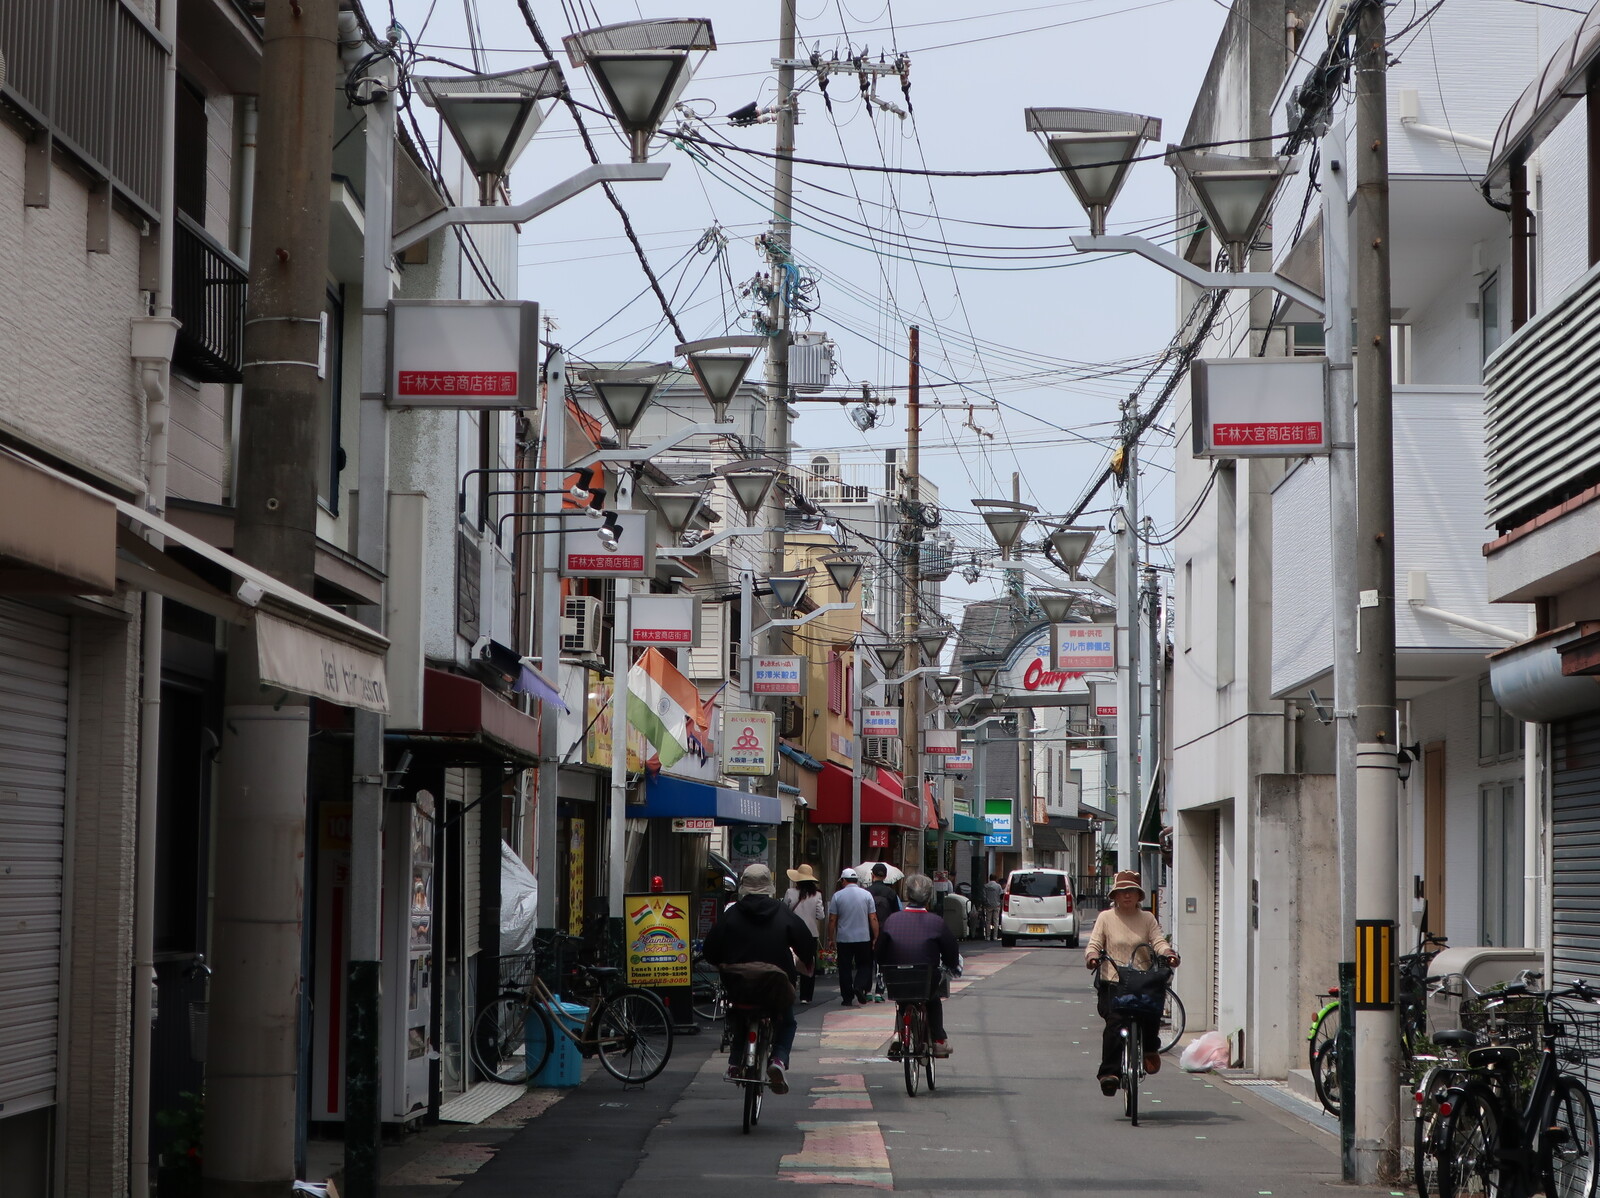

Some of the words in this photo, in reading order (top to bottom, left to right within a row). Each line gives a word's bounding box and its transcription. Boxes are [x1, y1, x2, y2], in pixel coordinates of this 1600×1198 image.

[401, 375, 514, 393] 千林大宮商店街(振)
[1216, 426, 1320, 442] 千林大宮商店街(振)
[756, 670, 798, 679] 野澤米穀店
[988, 835, 1008, 843] たばこ
